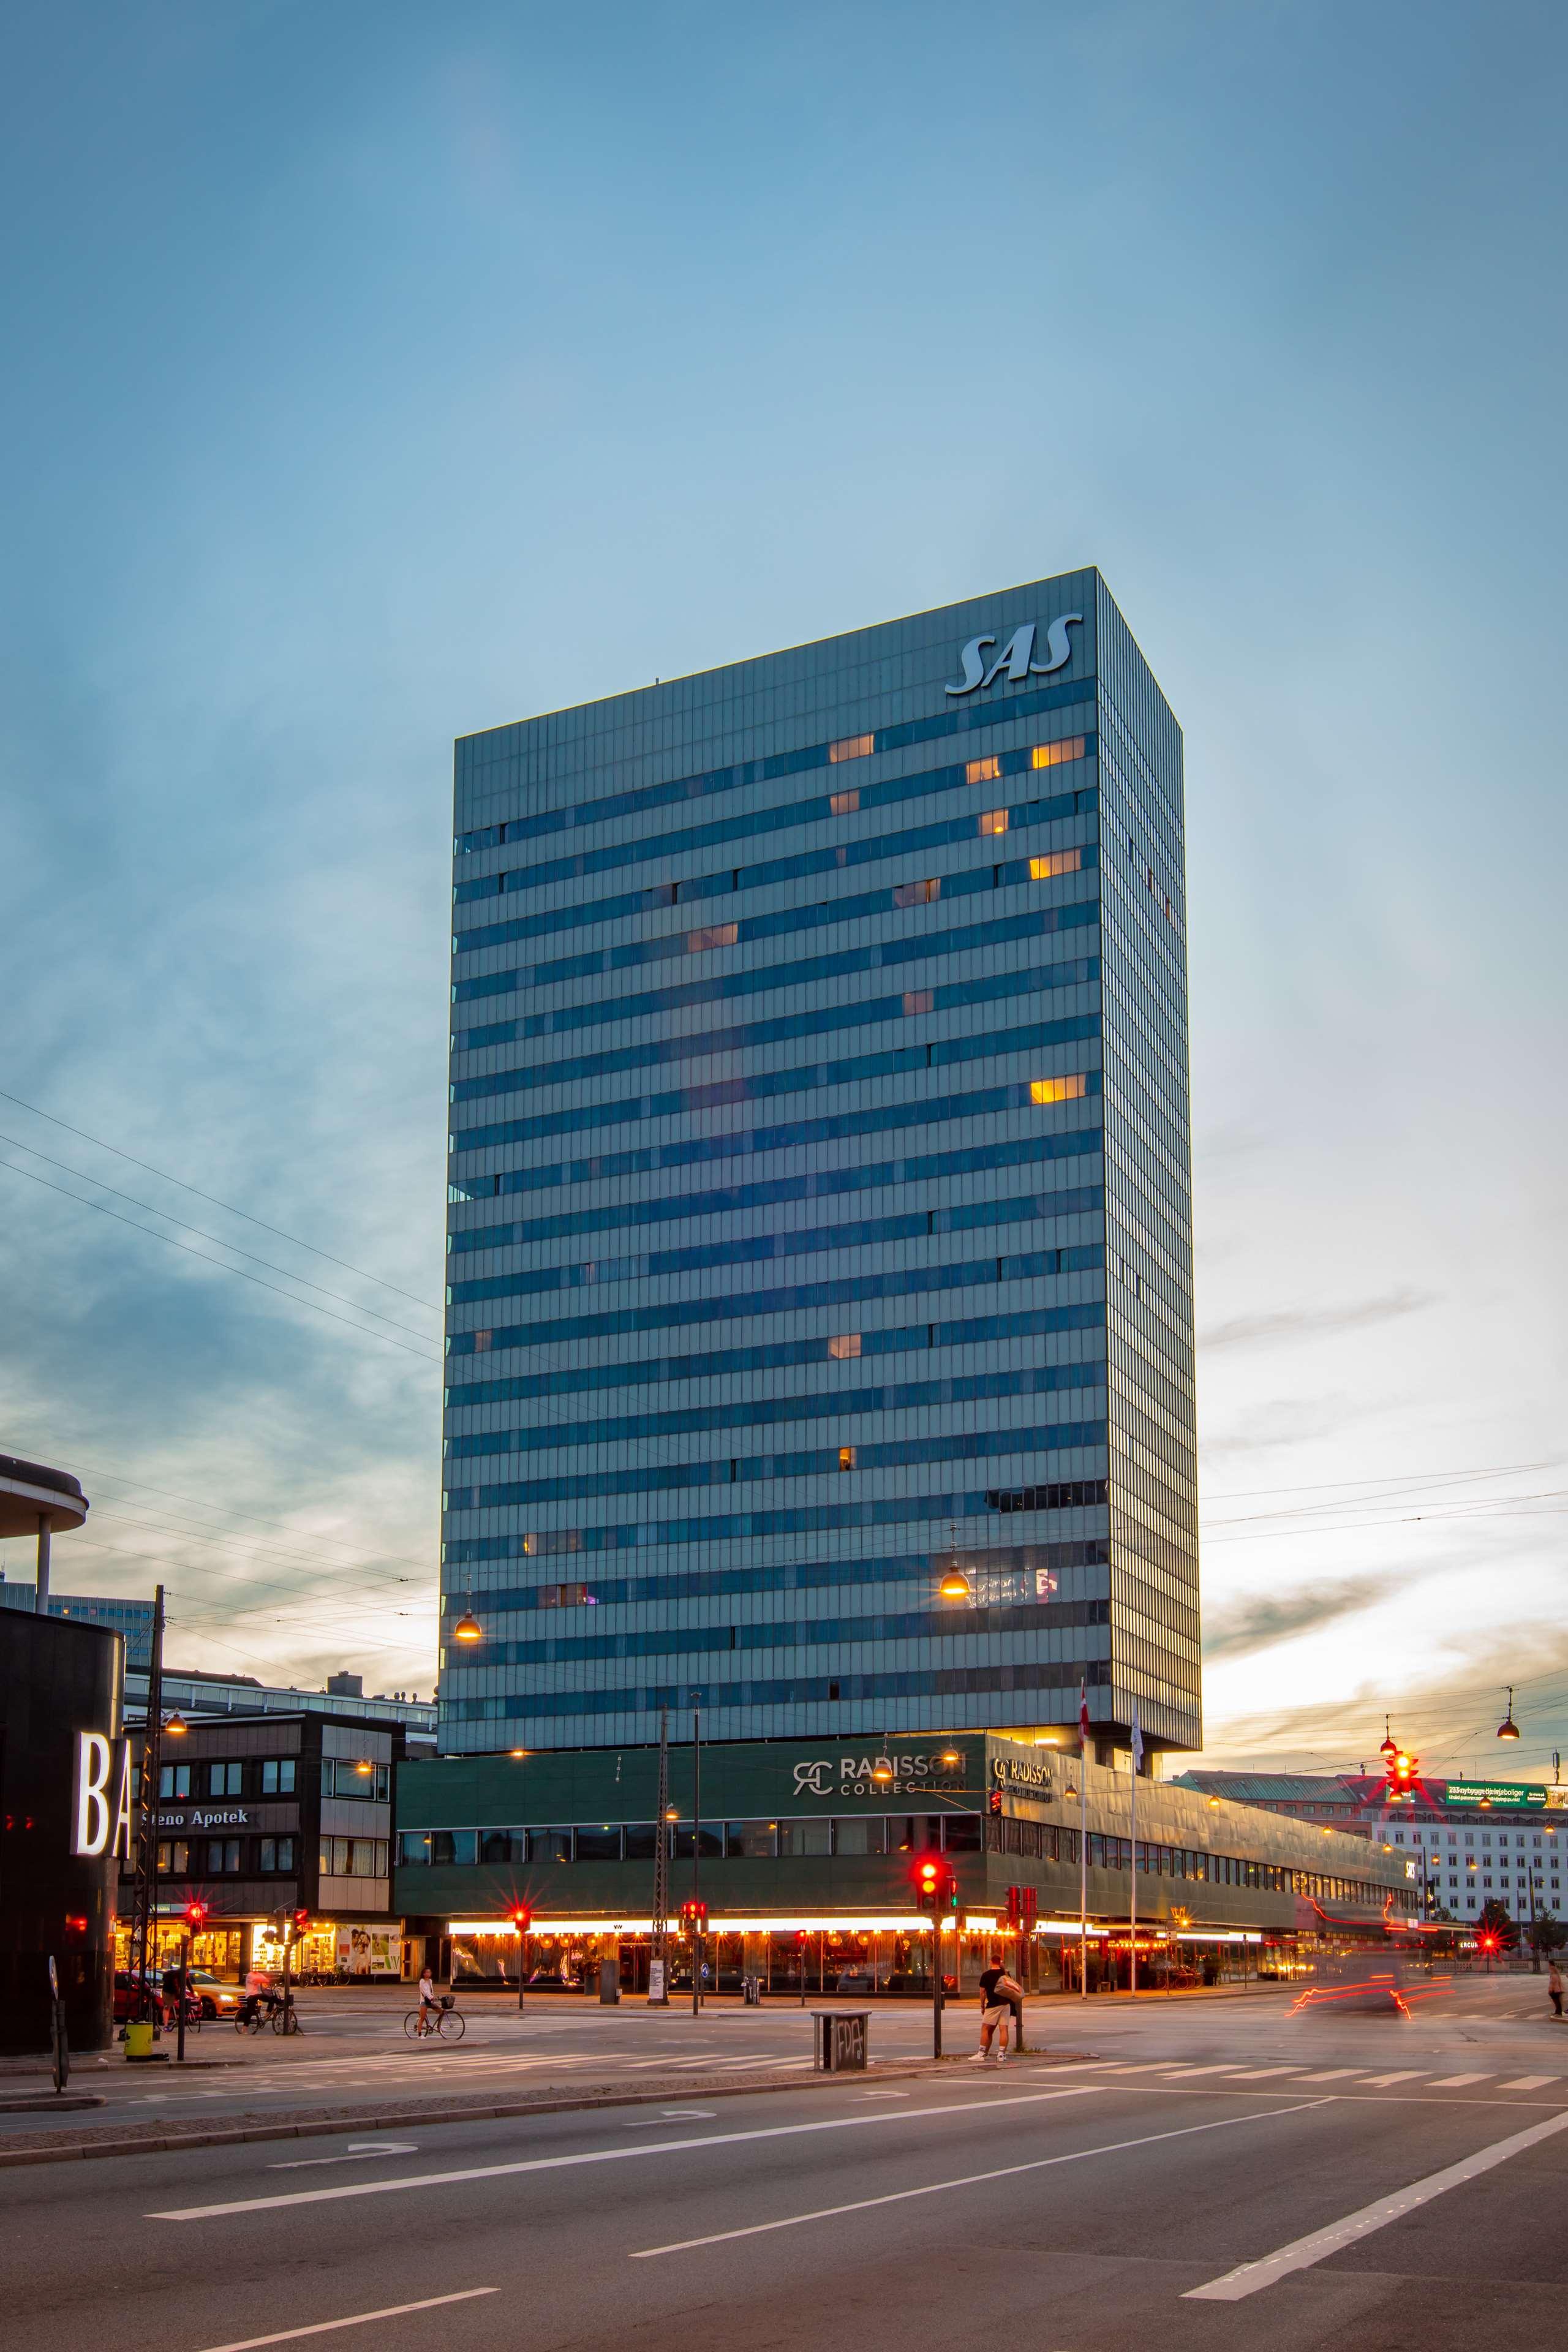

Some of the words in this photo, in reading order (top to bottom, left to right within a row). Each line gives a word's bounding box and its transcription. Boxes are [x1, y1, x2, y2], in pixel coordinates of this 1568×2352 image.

[945, 613, 1083, 695] SAS
[1011, 1759, 1053, 1787] RADISSON
[840, 1780, 967, 1796] COLLECTION
[191, 1809, 249, 1828] Apotek
